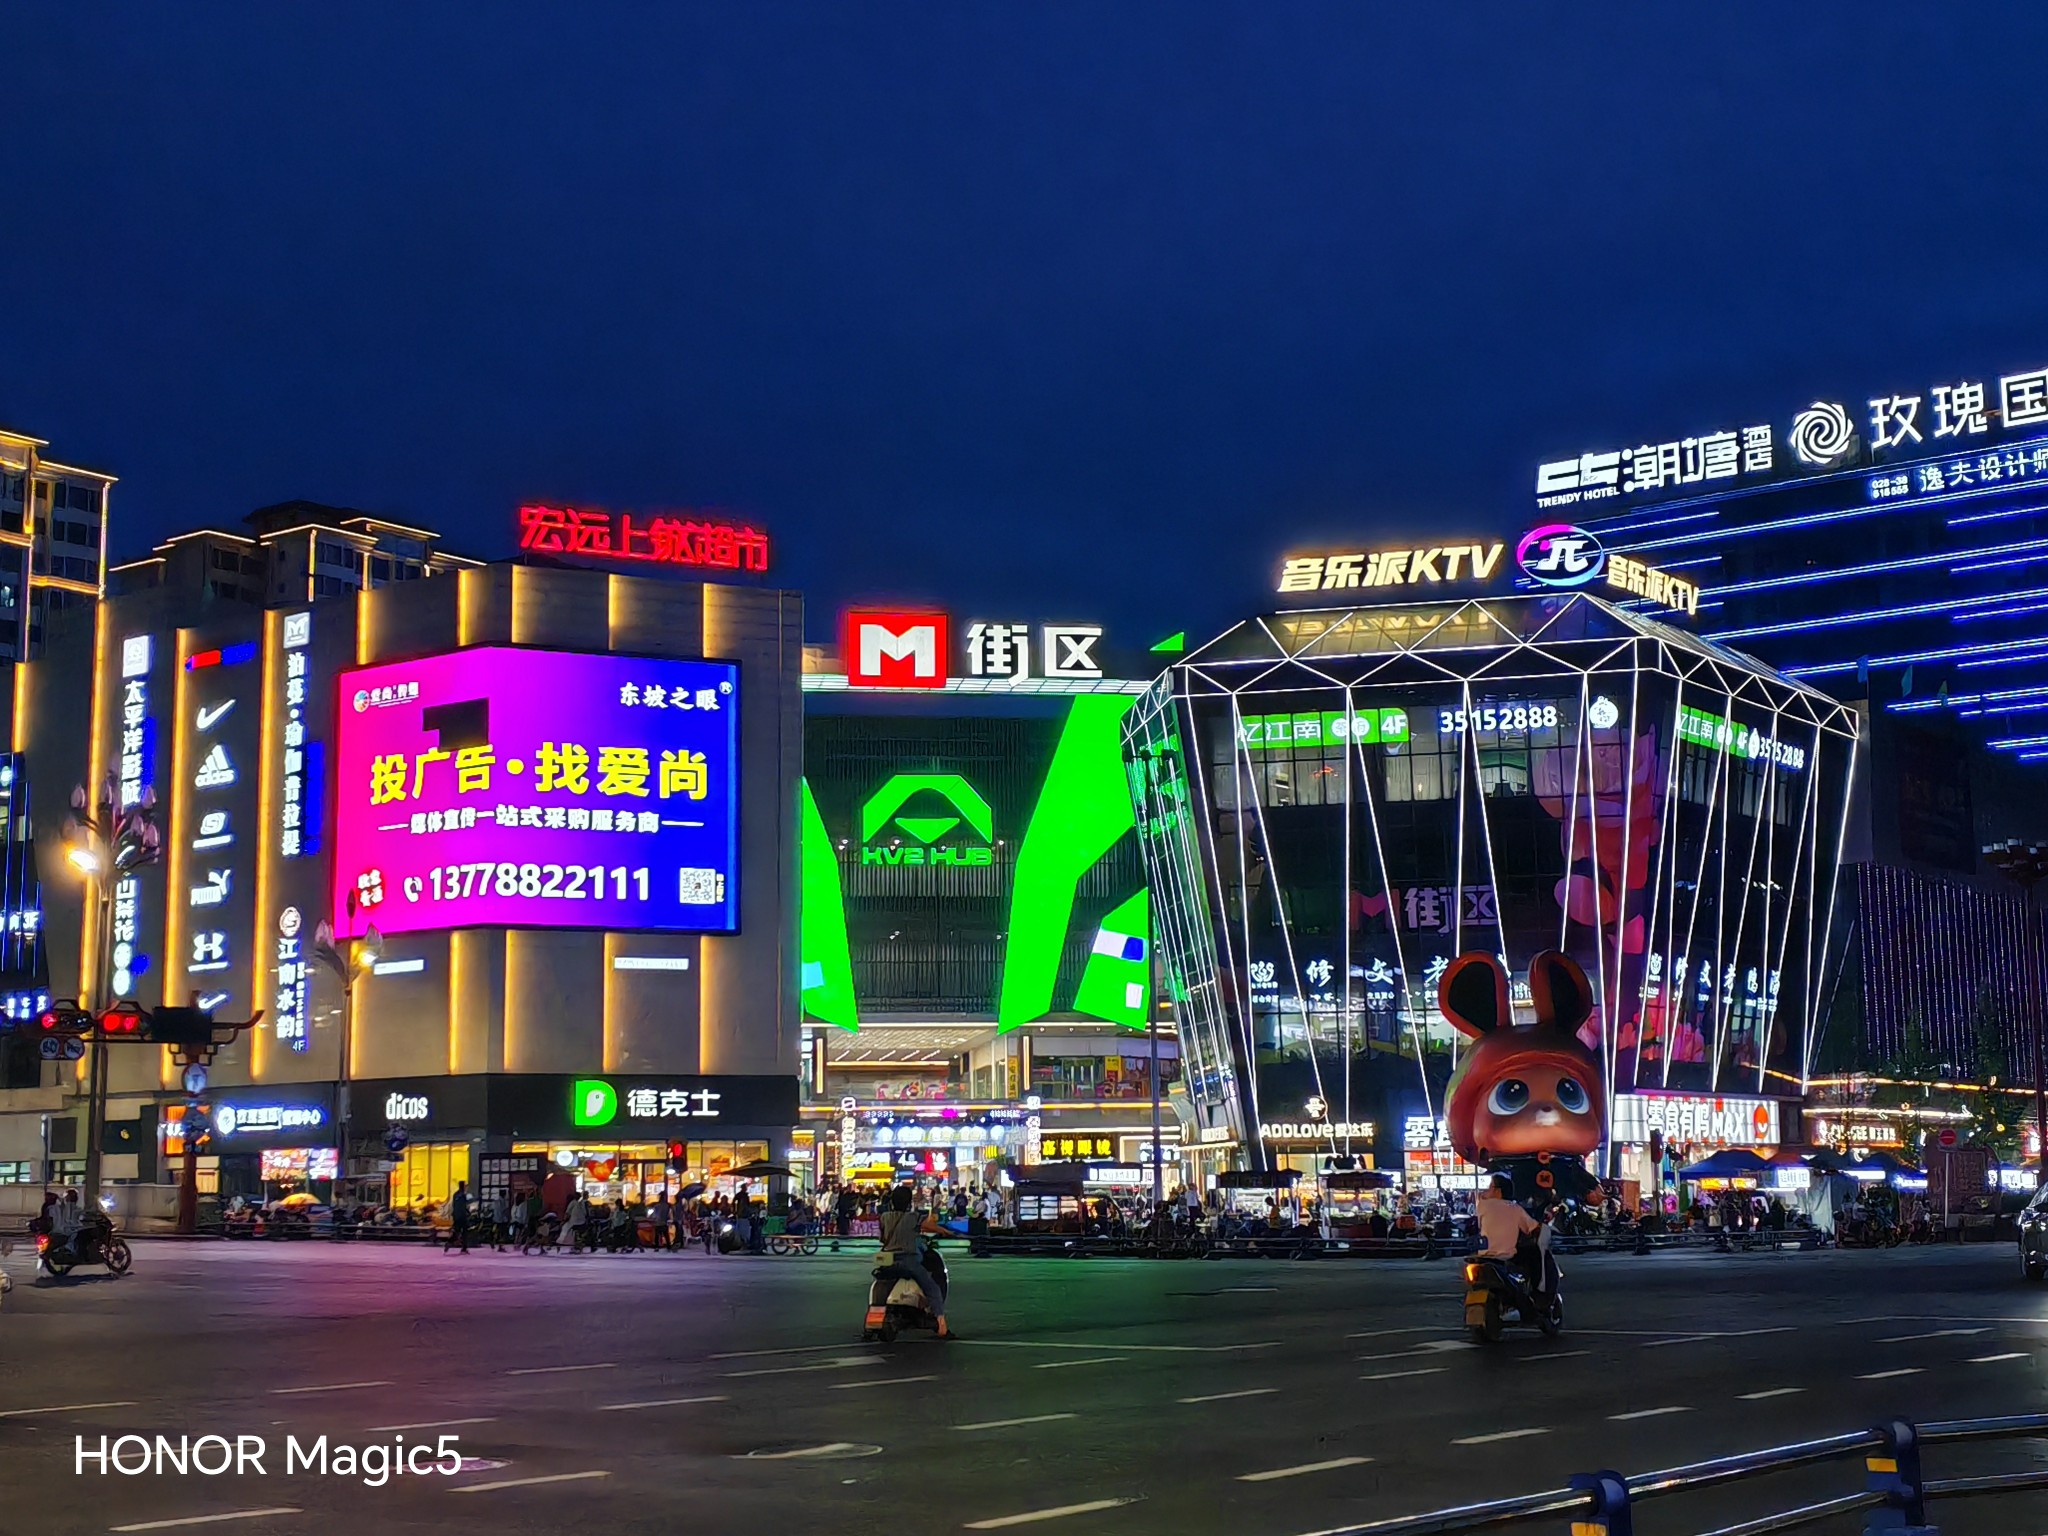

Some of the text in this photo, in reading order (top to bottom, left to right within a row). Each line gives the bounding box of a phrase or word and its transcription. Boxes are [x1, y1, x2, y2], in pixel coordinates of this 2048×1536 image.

[1537, 486, 1620, 508] TRENDY HOTEL
[1277, 543, 1505, 593] 音乐派KTV
[1606, 553, 1701, 616] 音乐派KTV
[860, 623, 936, 678] M
[966, 623, 1103, 687] 街区
[619, 682, 720, 711] 东坡之眼
[1381, 714, 1408, 736] 4F
[1440, 706, 1558, 733] 35152888
[429, 862, 650, 902] 13778822111
[386, 1095, 428, 1119] dicos
[627, 1089, 720, 1118] 德克士
[1711, 1111, 1746, 1139] MAX
